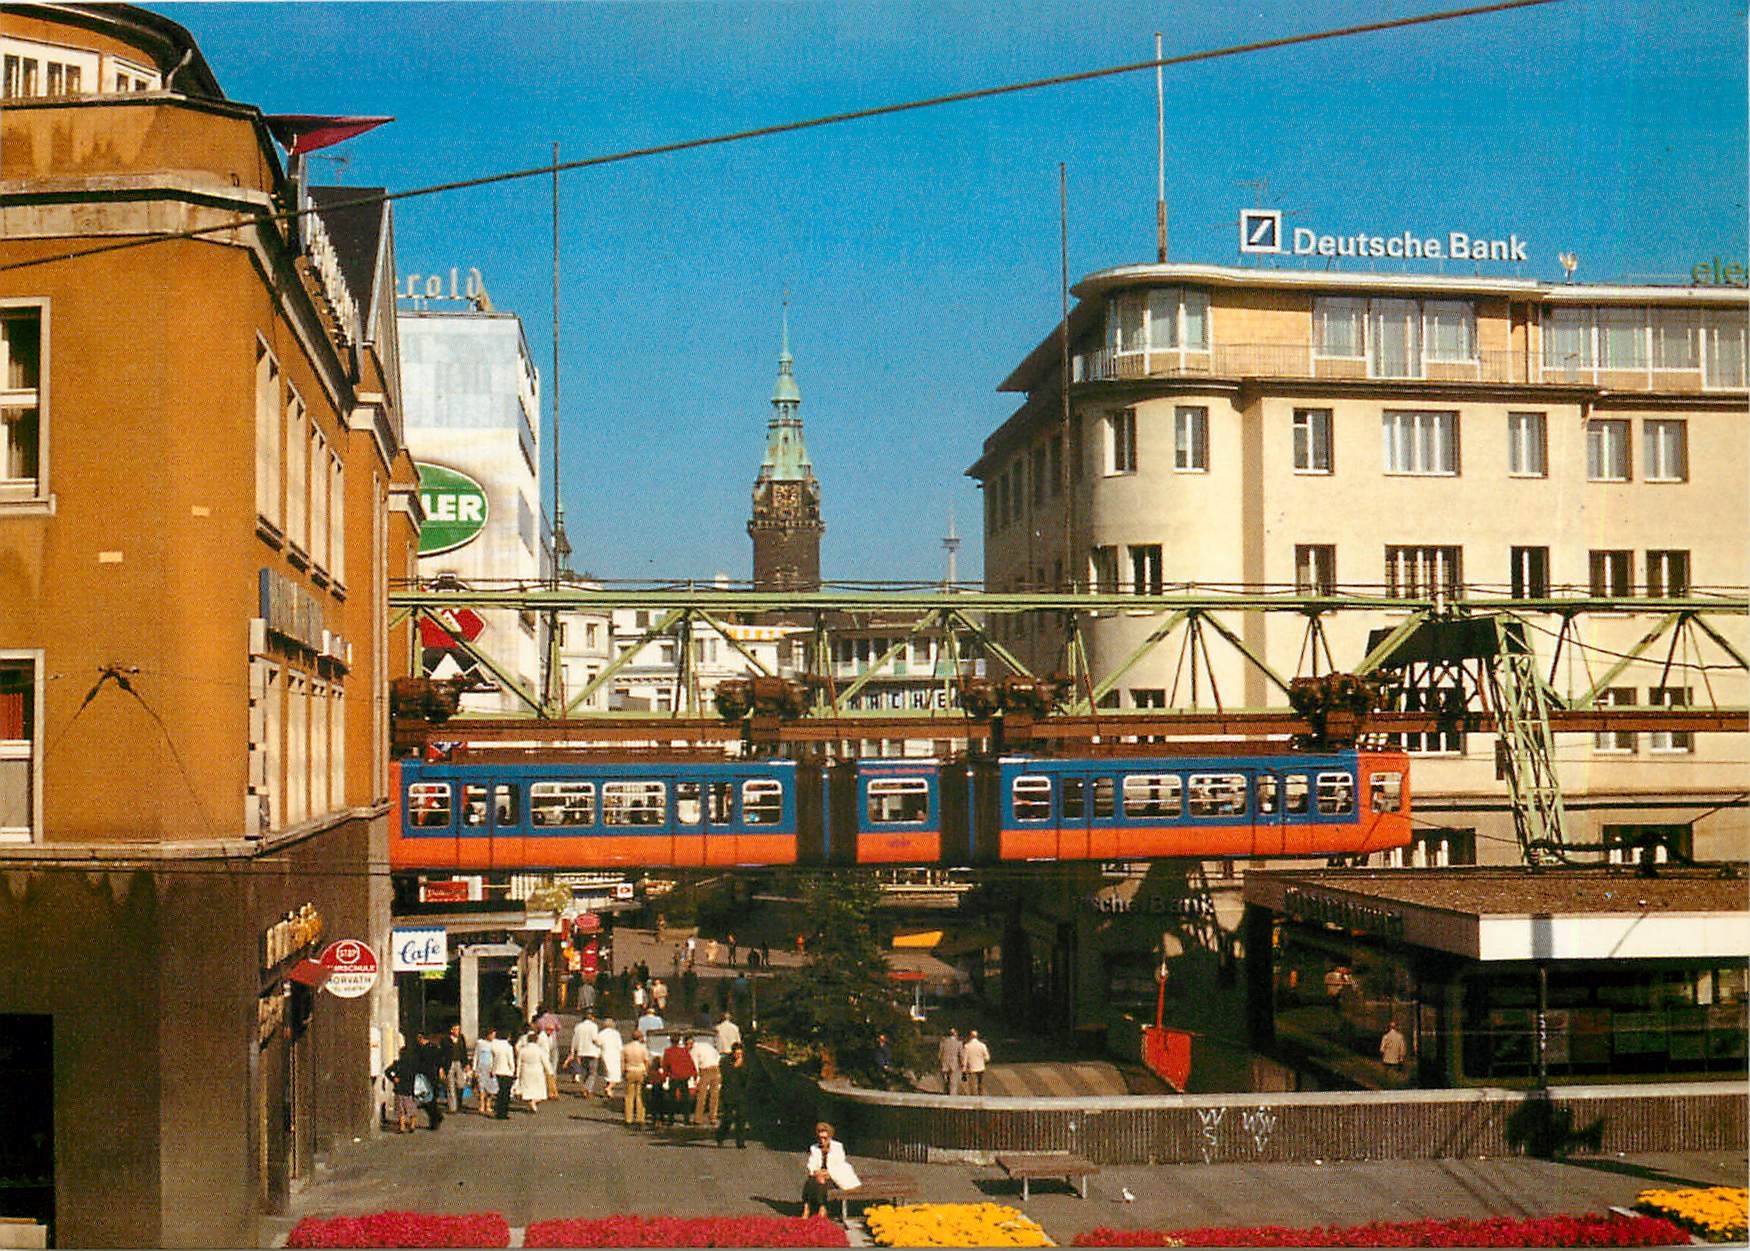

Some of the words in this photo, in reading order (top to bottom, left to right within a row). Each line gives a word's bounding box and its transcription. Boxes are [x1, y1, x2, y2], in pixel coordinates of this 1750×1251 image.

[1293, 228, 1441, 259] Deutsche
[1449, 232, 1527, 260] Bank
[396, 267, 483, 298] rold
